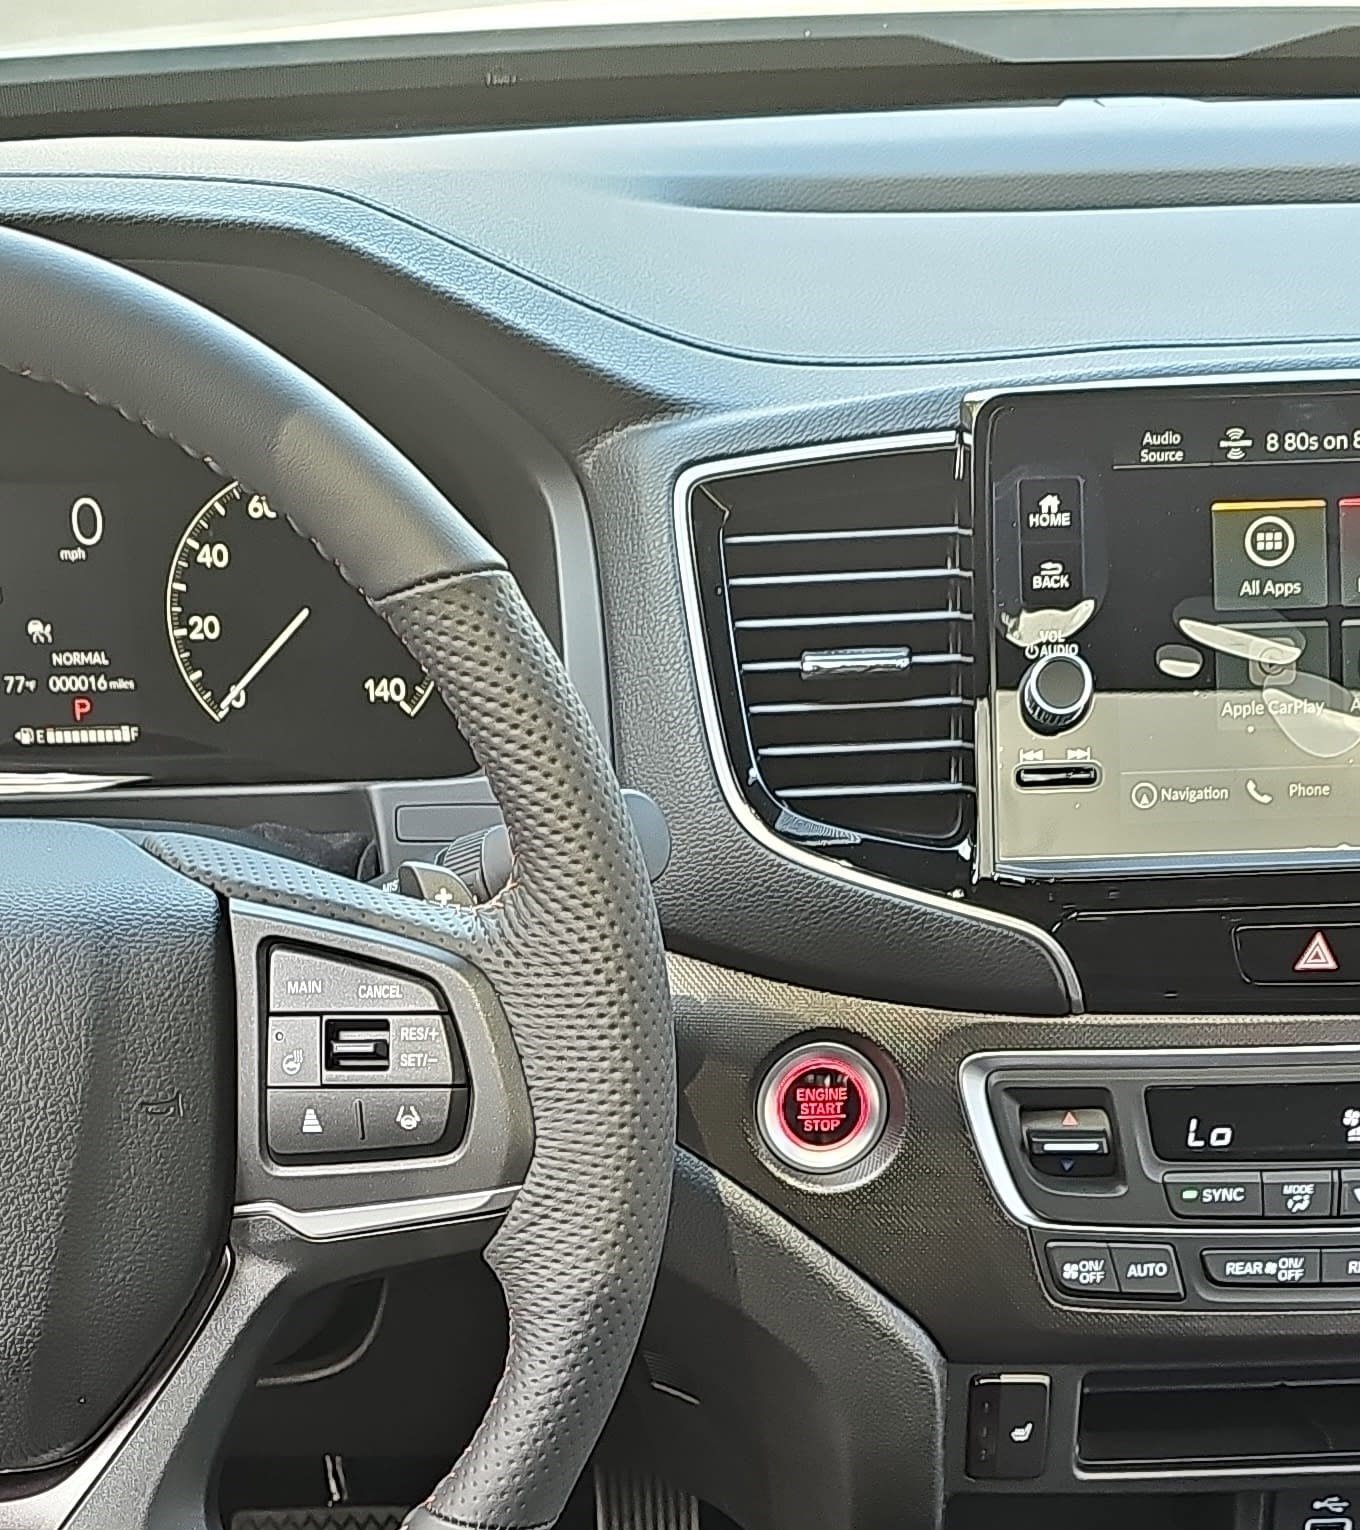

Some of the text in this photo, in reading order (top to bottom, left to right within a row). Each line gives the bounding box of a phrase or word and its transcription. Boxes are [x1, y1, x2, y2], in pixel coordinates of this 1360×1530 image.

[1142, 430, 1182, 447] Audio
[1266, 433, 1280, 452] 8
[1284, 433, 1319, 452] 80s
[1323, 435, 1349, 450] on
[1140, 447, 1184, 463] Source
[71, 497, 104, 546] 0
[1028, 511, 1072, 528] HOME
[59, 548, 86, 564] mph
[196, 543, 229, 568] 40
[1032, 573, 1070, 590] BACK
[1240, 579, 1302, 598] All Apps
[188, 615, 220, 641] 20
[1039, 629, 1066, 644] VOL
[51, 651, 110, 666] NORMAL
[1040, 643, 1080, 658] AUDIO
[48, 674, 108, 692] 000016
[364, 678, 407, 702] 140
[74, 698, 92, 721] P
[1221, 700, 1326, 719] Apple CarPlay
[36, 729, 46, 744] E
[130, 725, 140, 741] F
[1160, 785, 1230, 804] Navigation
[1288, 781, 1331, 798] Phone
[287, 981, 322, 994] MAIN
[358, 985, 403, 999] CANCEL
[400, 1026, 439, 1042] RES/+
[796, 1087, 849, 1102] ENGINE
[800, 1102, 844, 1115] START
[803, 1119, 840, 1131] STOP
[1187, 1116, 1233, 1148] Lo
[1201, 1187, 1245, 1203] SYNC
[1283, 1184, 1315, 1195] MODE
[1079, 1259, 1105, 1272] ON/
[1126, 1262, 1168, 1278] AUTO
[1225, 1260, 1264, 1276] REAR
[1278, 1256, 1305, 1271] ON/
[1078, 1271, 1105, 1285] OFF
[1277, 1268, 1305, 1282] OFF
